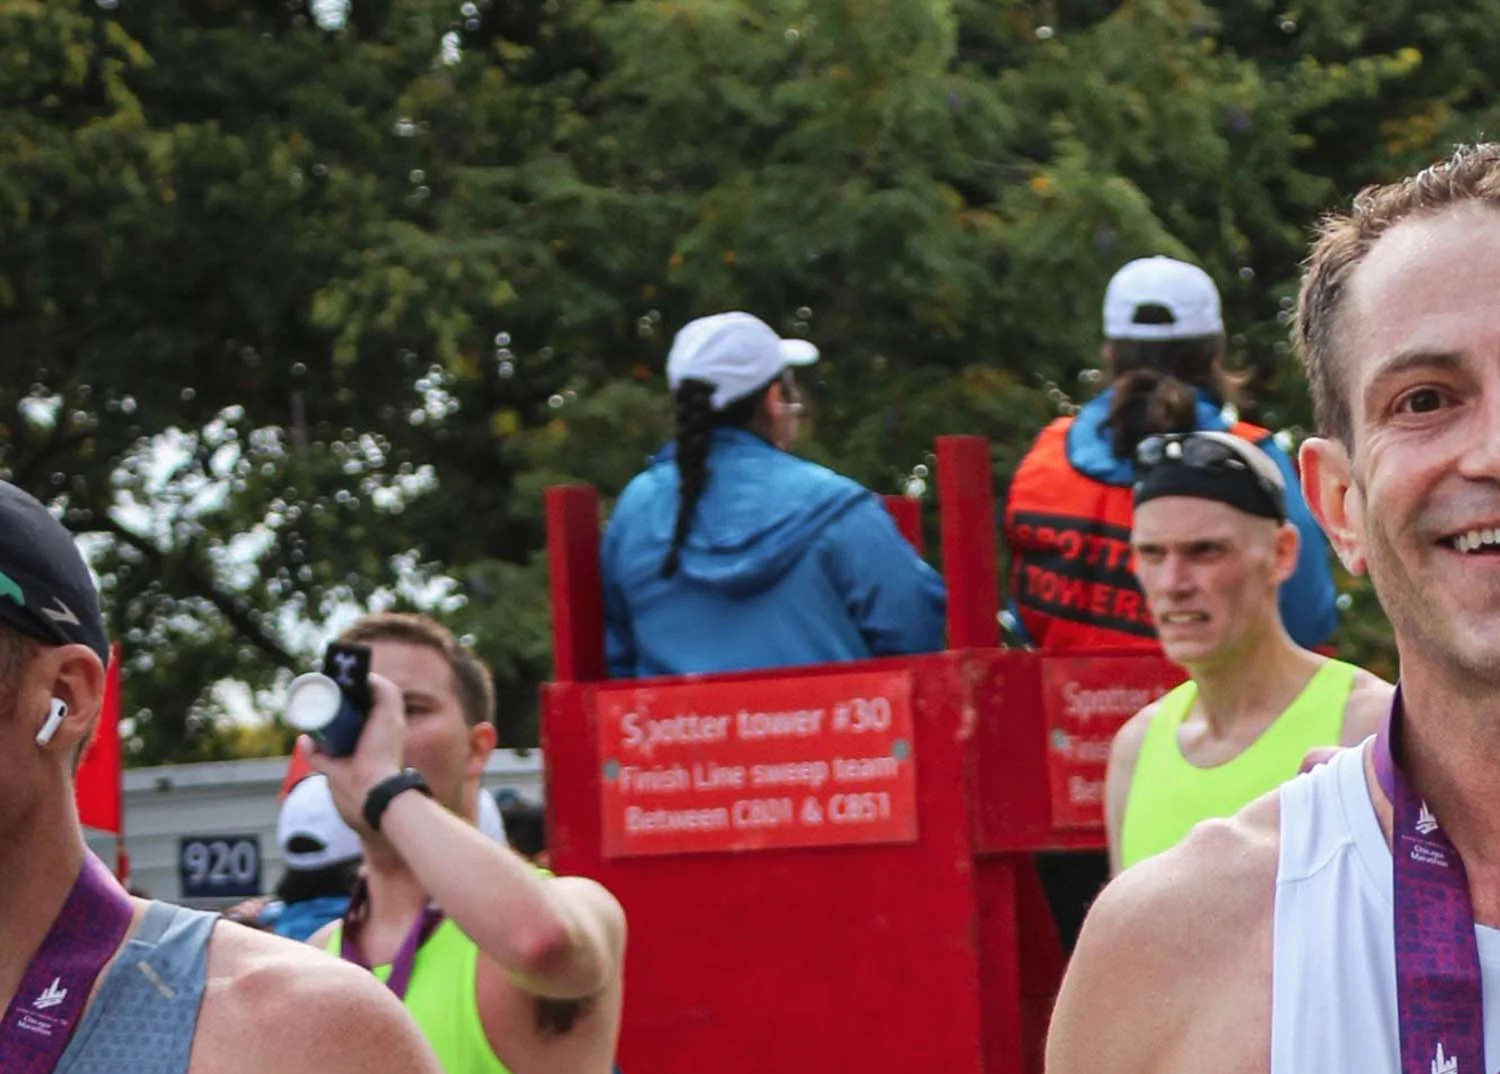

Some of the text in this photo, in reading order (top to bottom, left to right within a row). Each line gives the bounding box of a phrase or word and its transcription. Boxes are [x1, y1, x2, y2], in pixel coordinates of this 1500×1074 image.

[1016, 524, 1137, 573] SPOTT
[622, 697, 891, 756] Spotter tower #30
[619, 756, 899, 794] Finish Line sweep team
[624, 805, 729, 833] Between
[801, 795, 823, 825] &
[184, 841, 256, 885] 920
